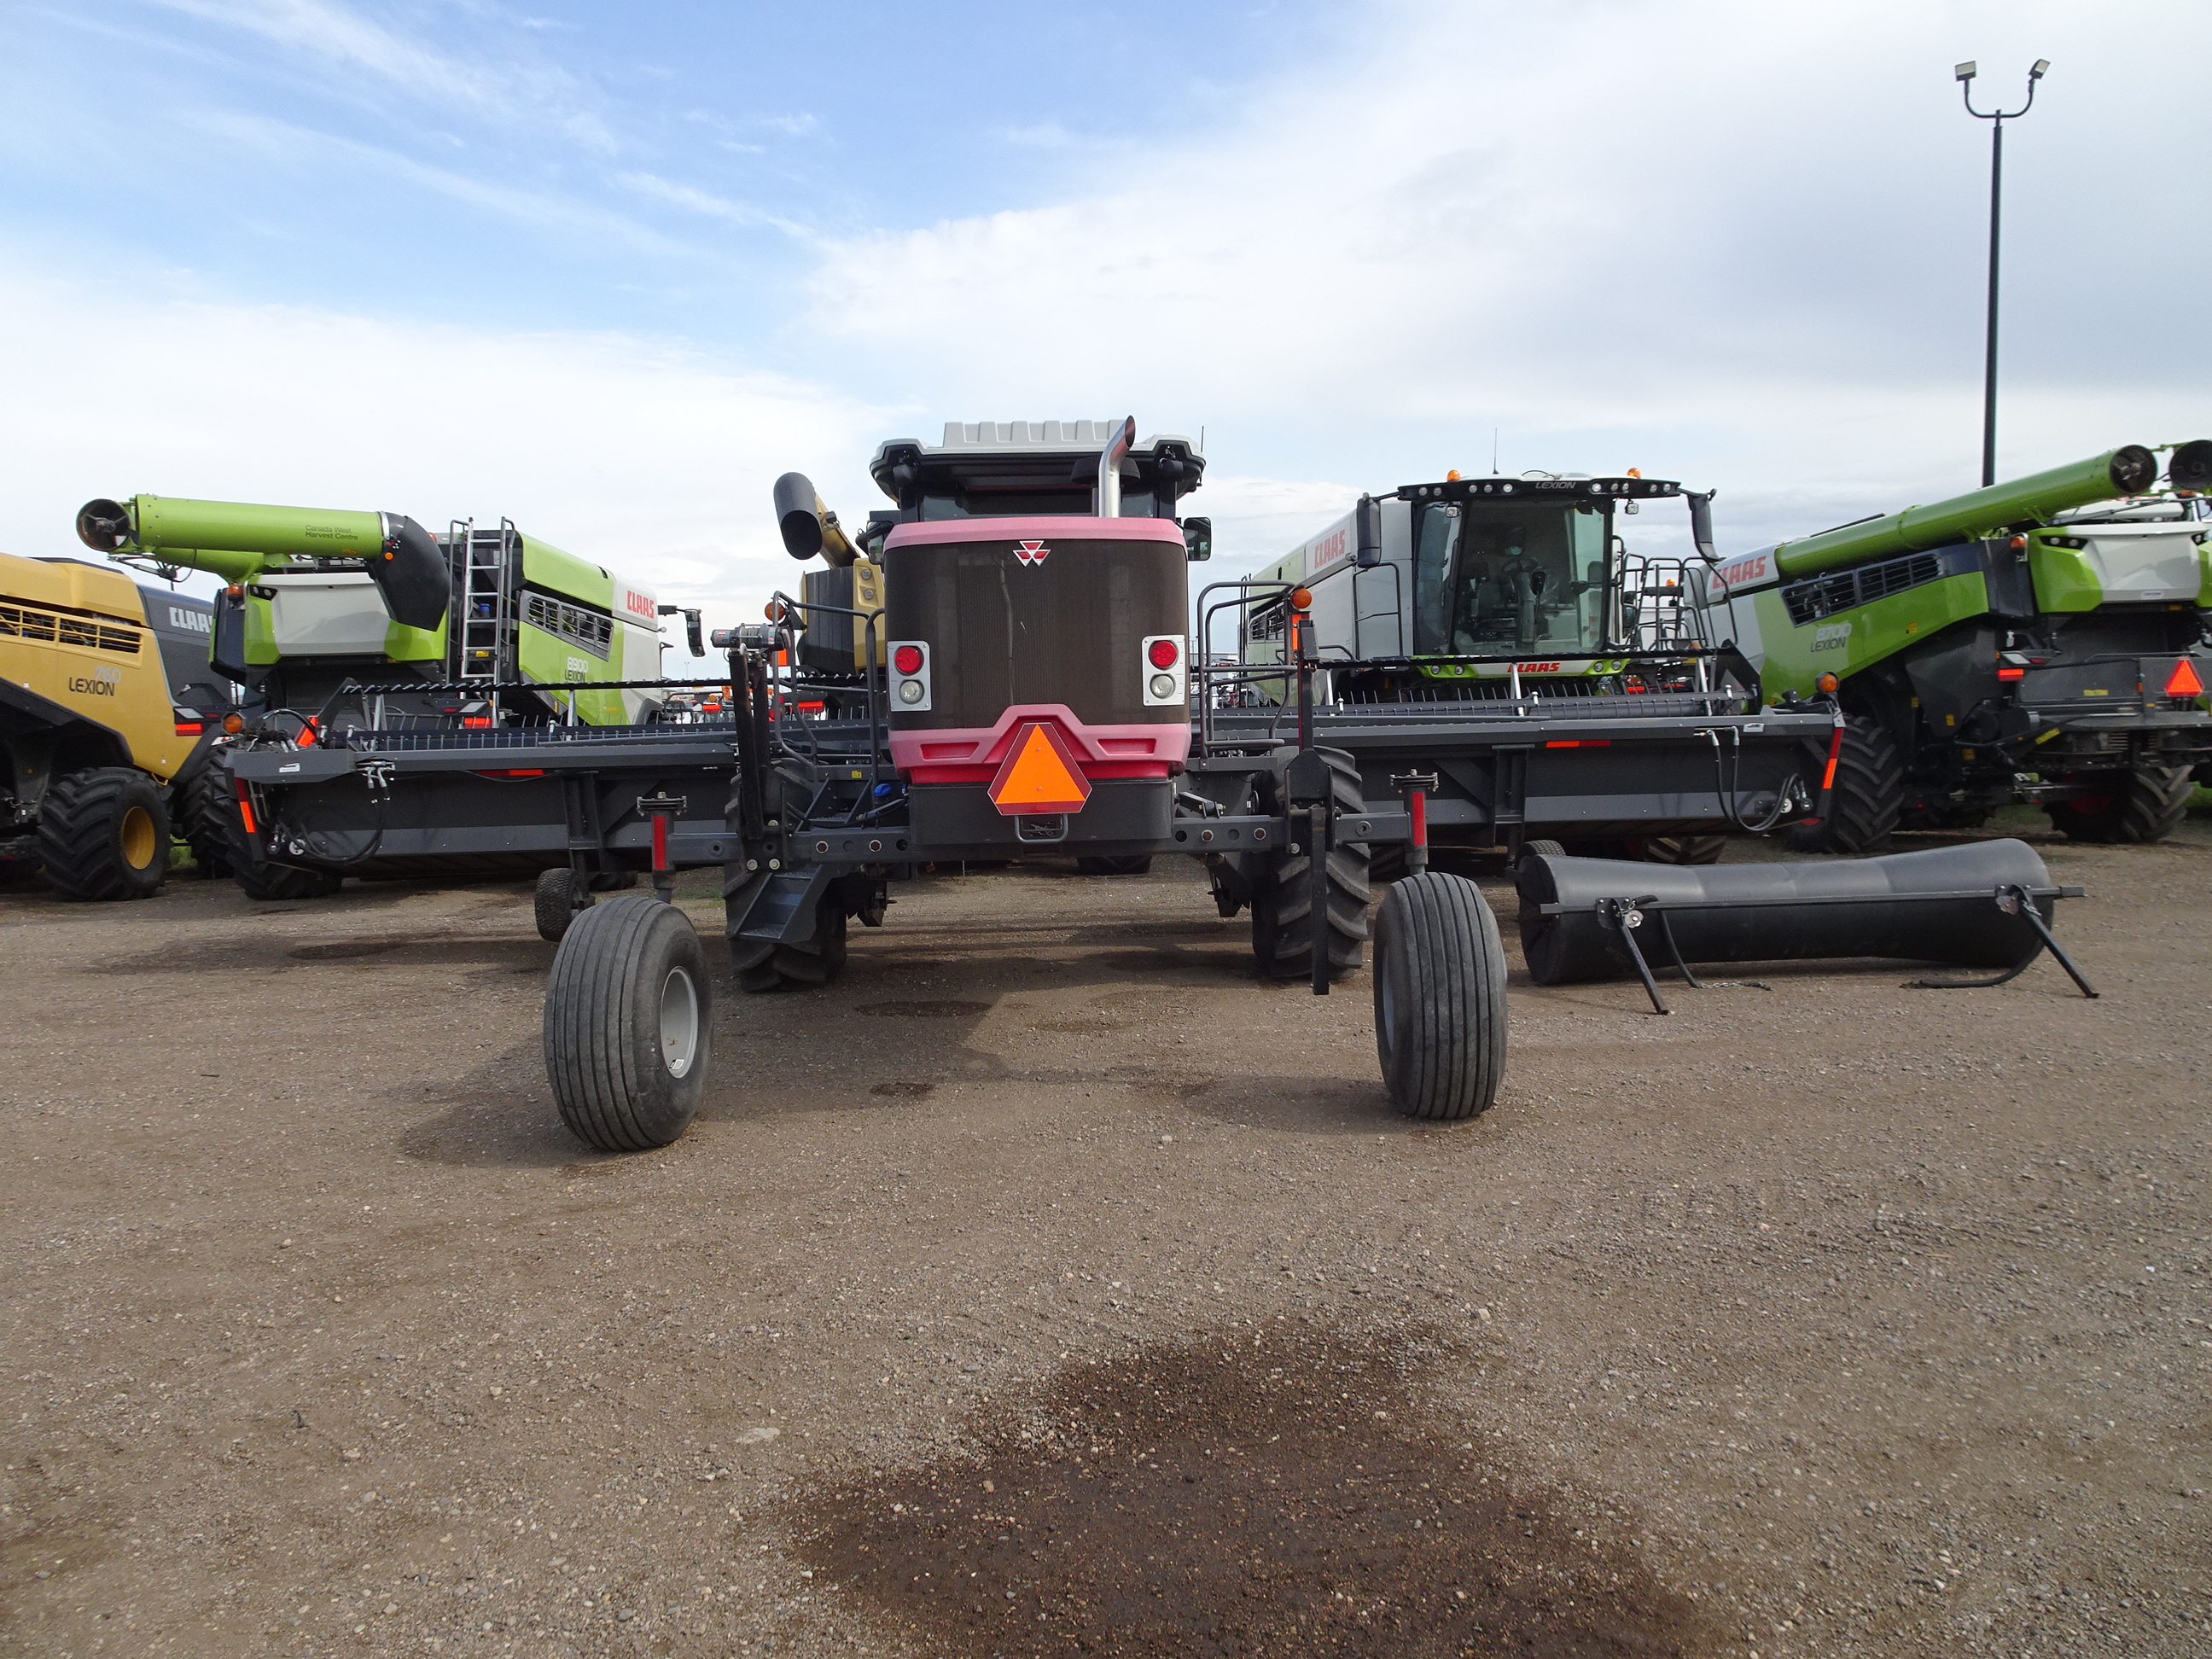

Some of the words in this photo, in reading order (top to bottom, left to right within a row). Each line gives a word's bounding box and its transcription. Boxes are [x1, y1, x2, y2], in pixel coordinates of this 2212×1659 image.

[1314, 529, 1345, 569] CLAAS
[1713, 555, 1767, 589] CLAAS
[627, 590, 655, 619] CLAAS
[1816, 622, 1852, 641] 8700
[1810, 637, 1847, 653] LEXION
[568, 656, 589, 672] 8900
[93, 666, 121, 683] 760
[565, 669, 586, 683] LEXION
[69, 677, 115, 696] LEXION
